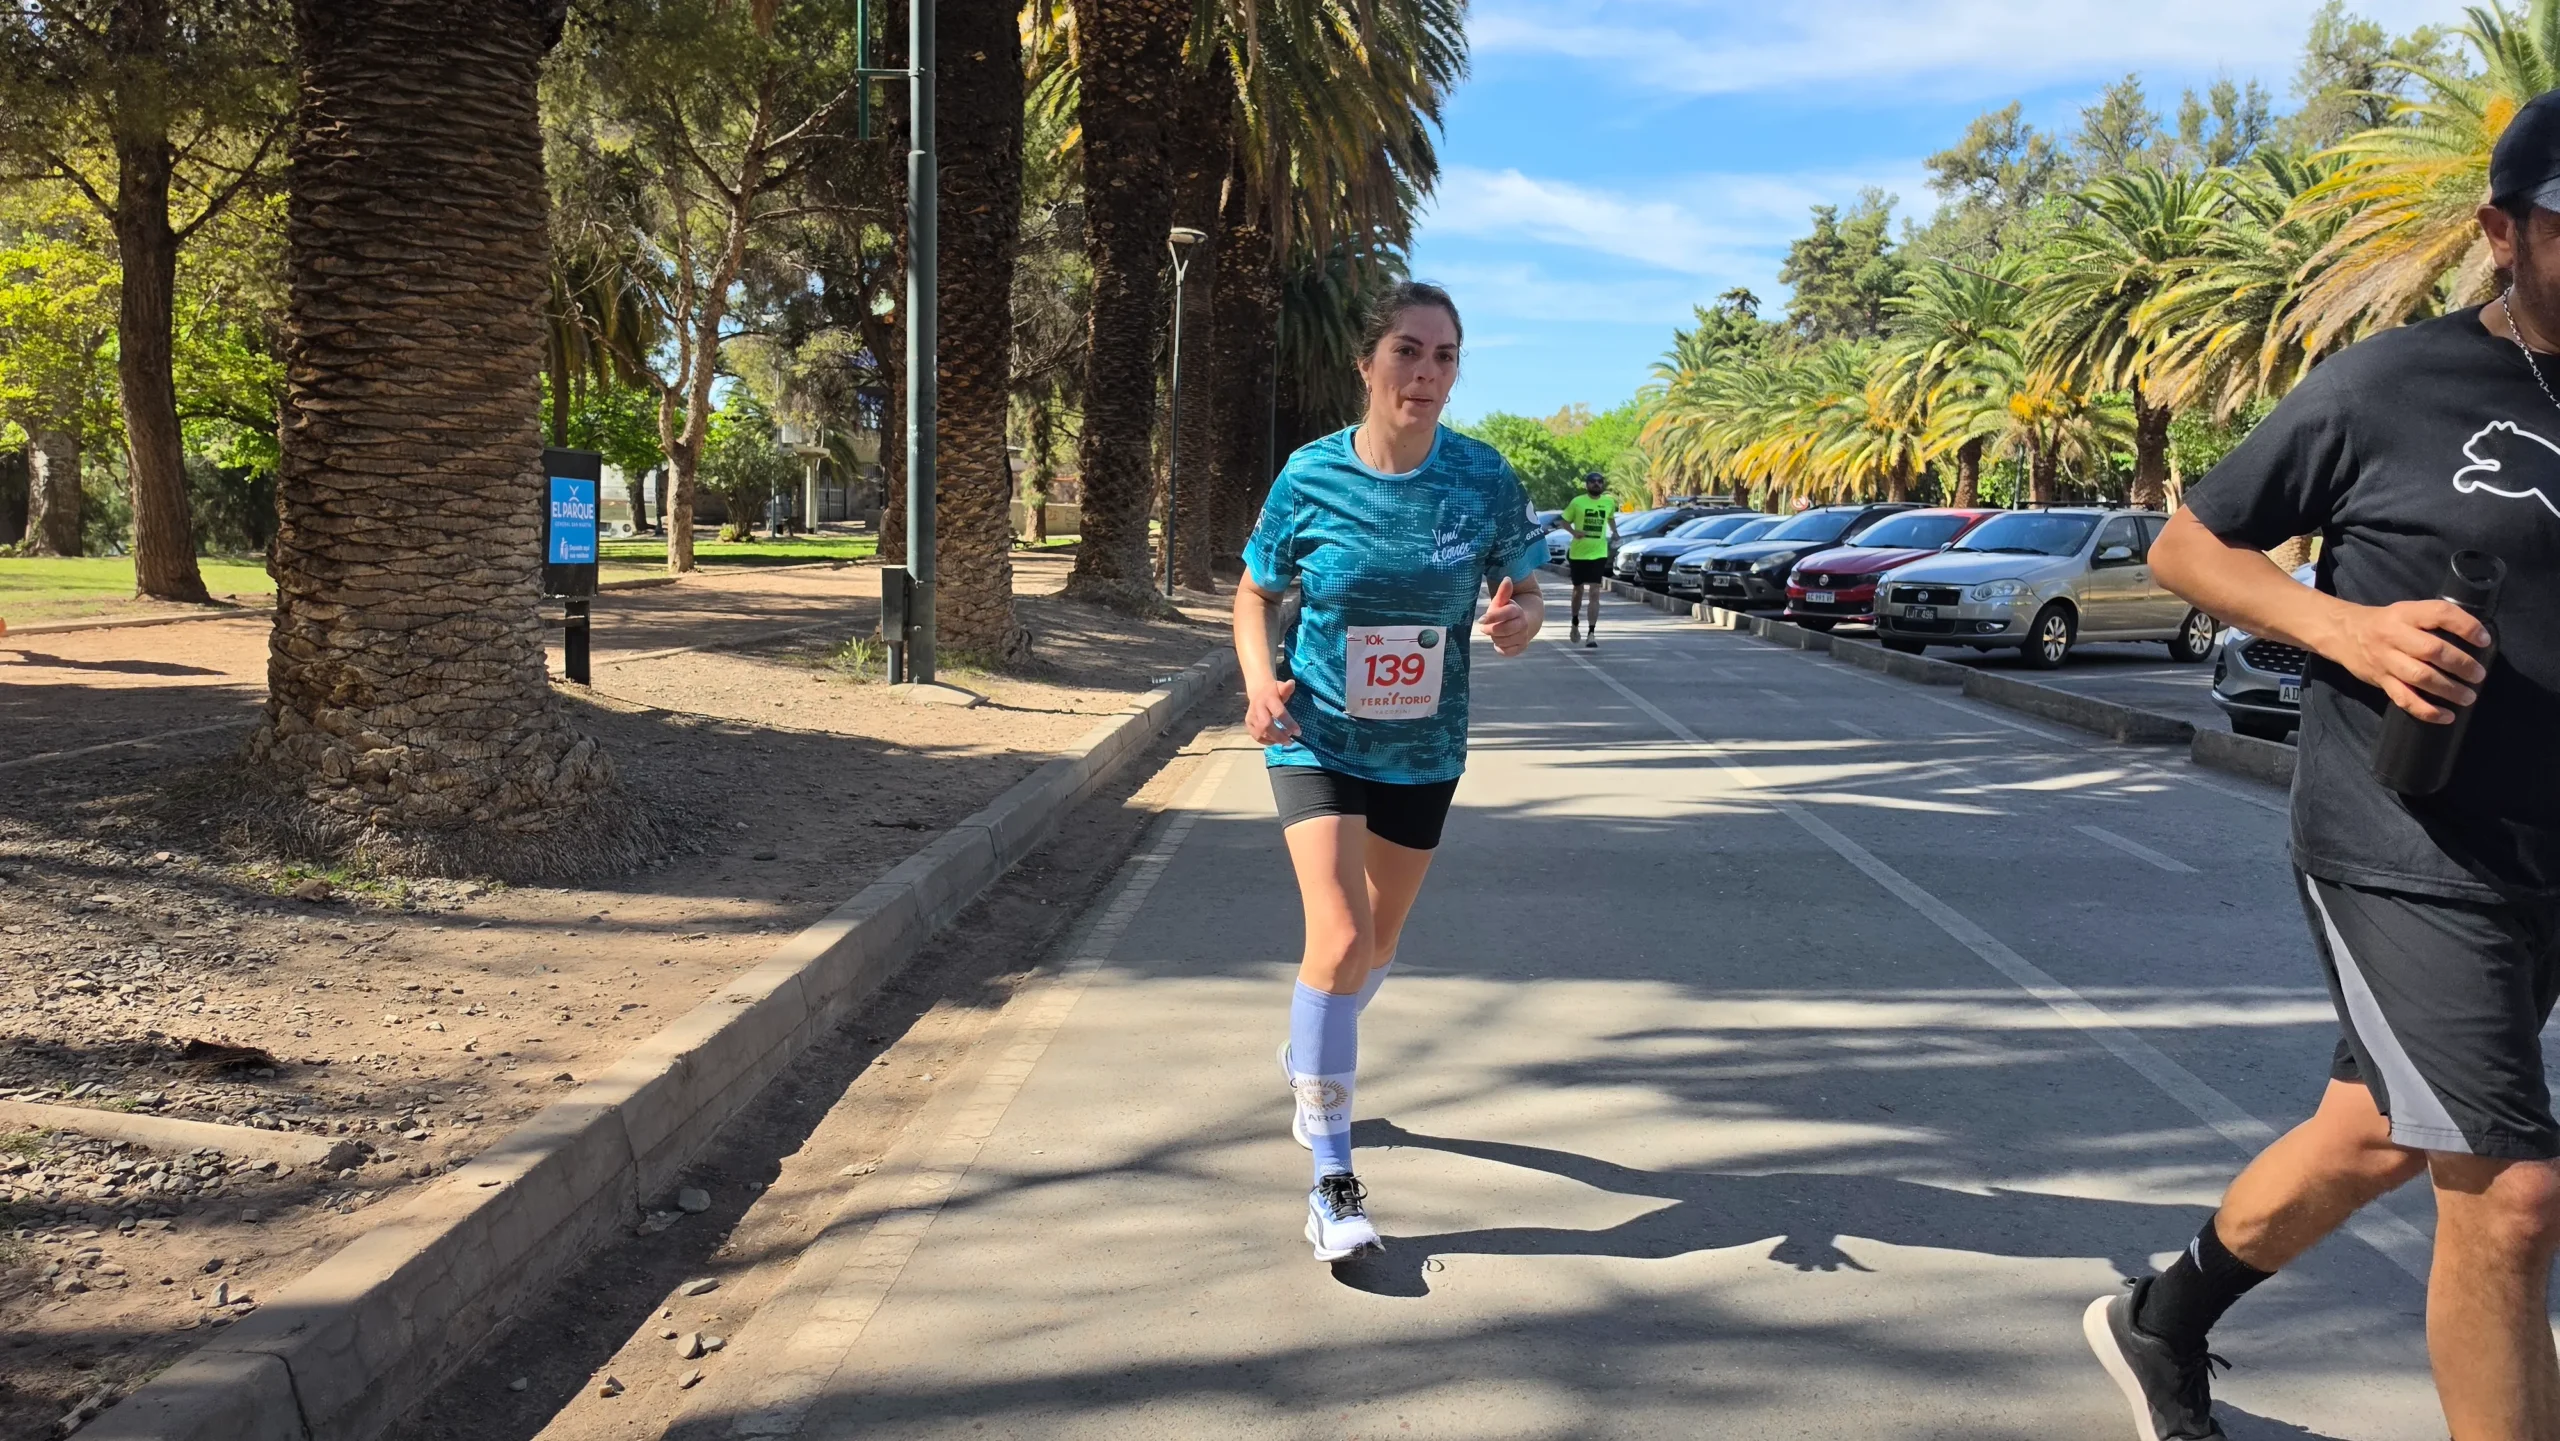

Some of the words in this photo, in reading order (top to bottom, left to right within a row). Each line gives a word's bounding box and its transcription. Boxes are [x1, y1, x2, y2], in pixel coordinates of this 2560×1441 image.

[552, 501, 562, 518] EL
[562, 502, 594, 520] PARQUE
[1905, 608, 1918, 619] LJT
[1921, 609, 1934, 620] 496
[1364, 634, 1384, 646] 10k
[1364, 653, 1425, 687] 139
[2283, 687, 2299, 700] AD
[1308, 1113, 1342, 1122] ARG
